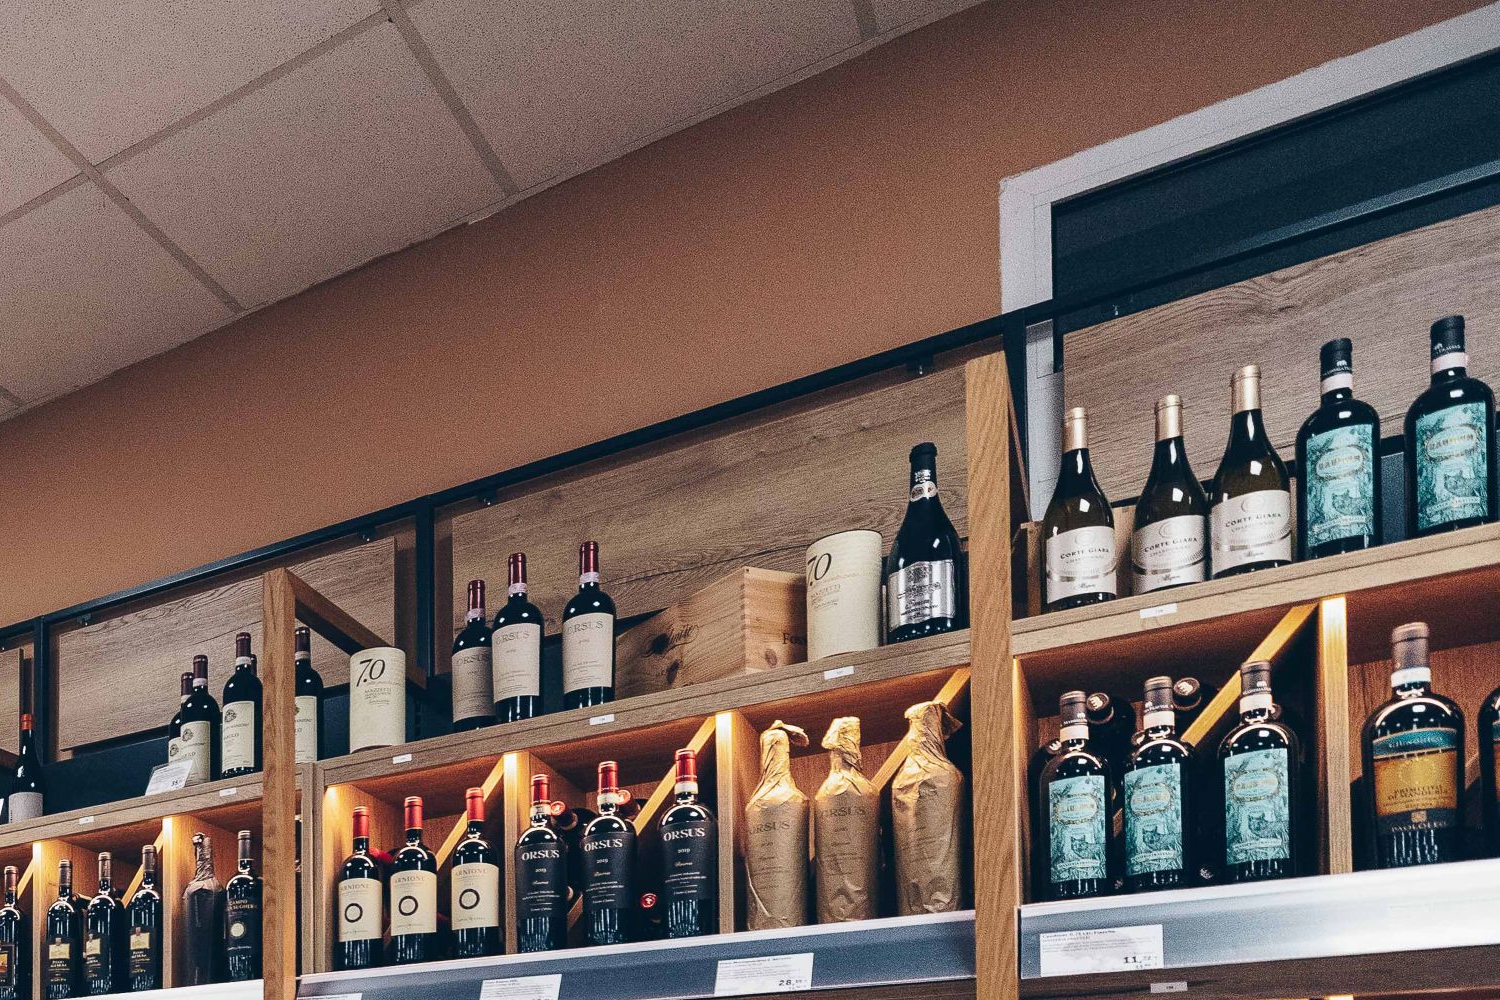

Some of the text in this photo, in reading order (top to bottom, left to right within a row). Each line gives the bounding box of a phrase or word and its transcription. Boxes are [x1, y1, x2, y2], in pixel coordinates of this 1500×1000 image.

[663, 827, 706, 842] ORSUS
[584, 838, 623, 852] ORSUS
[521, 849, 560, 861] ORSUS
